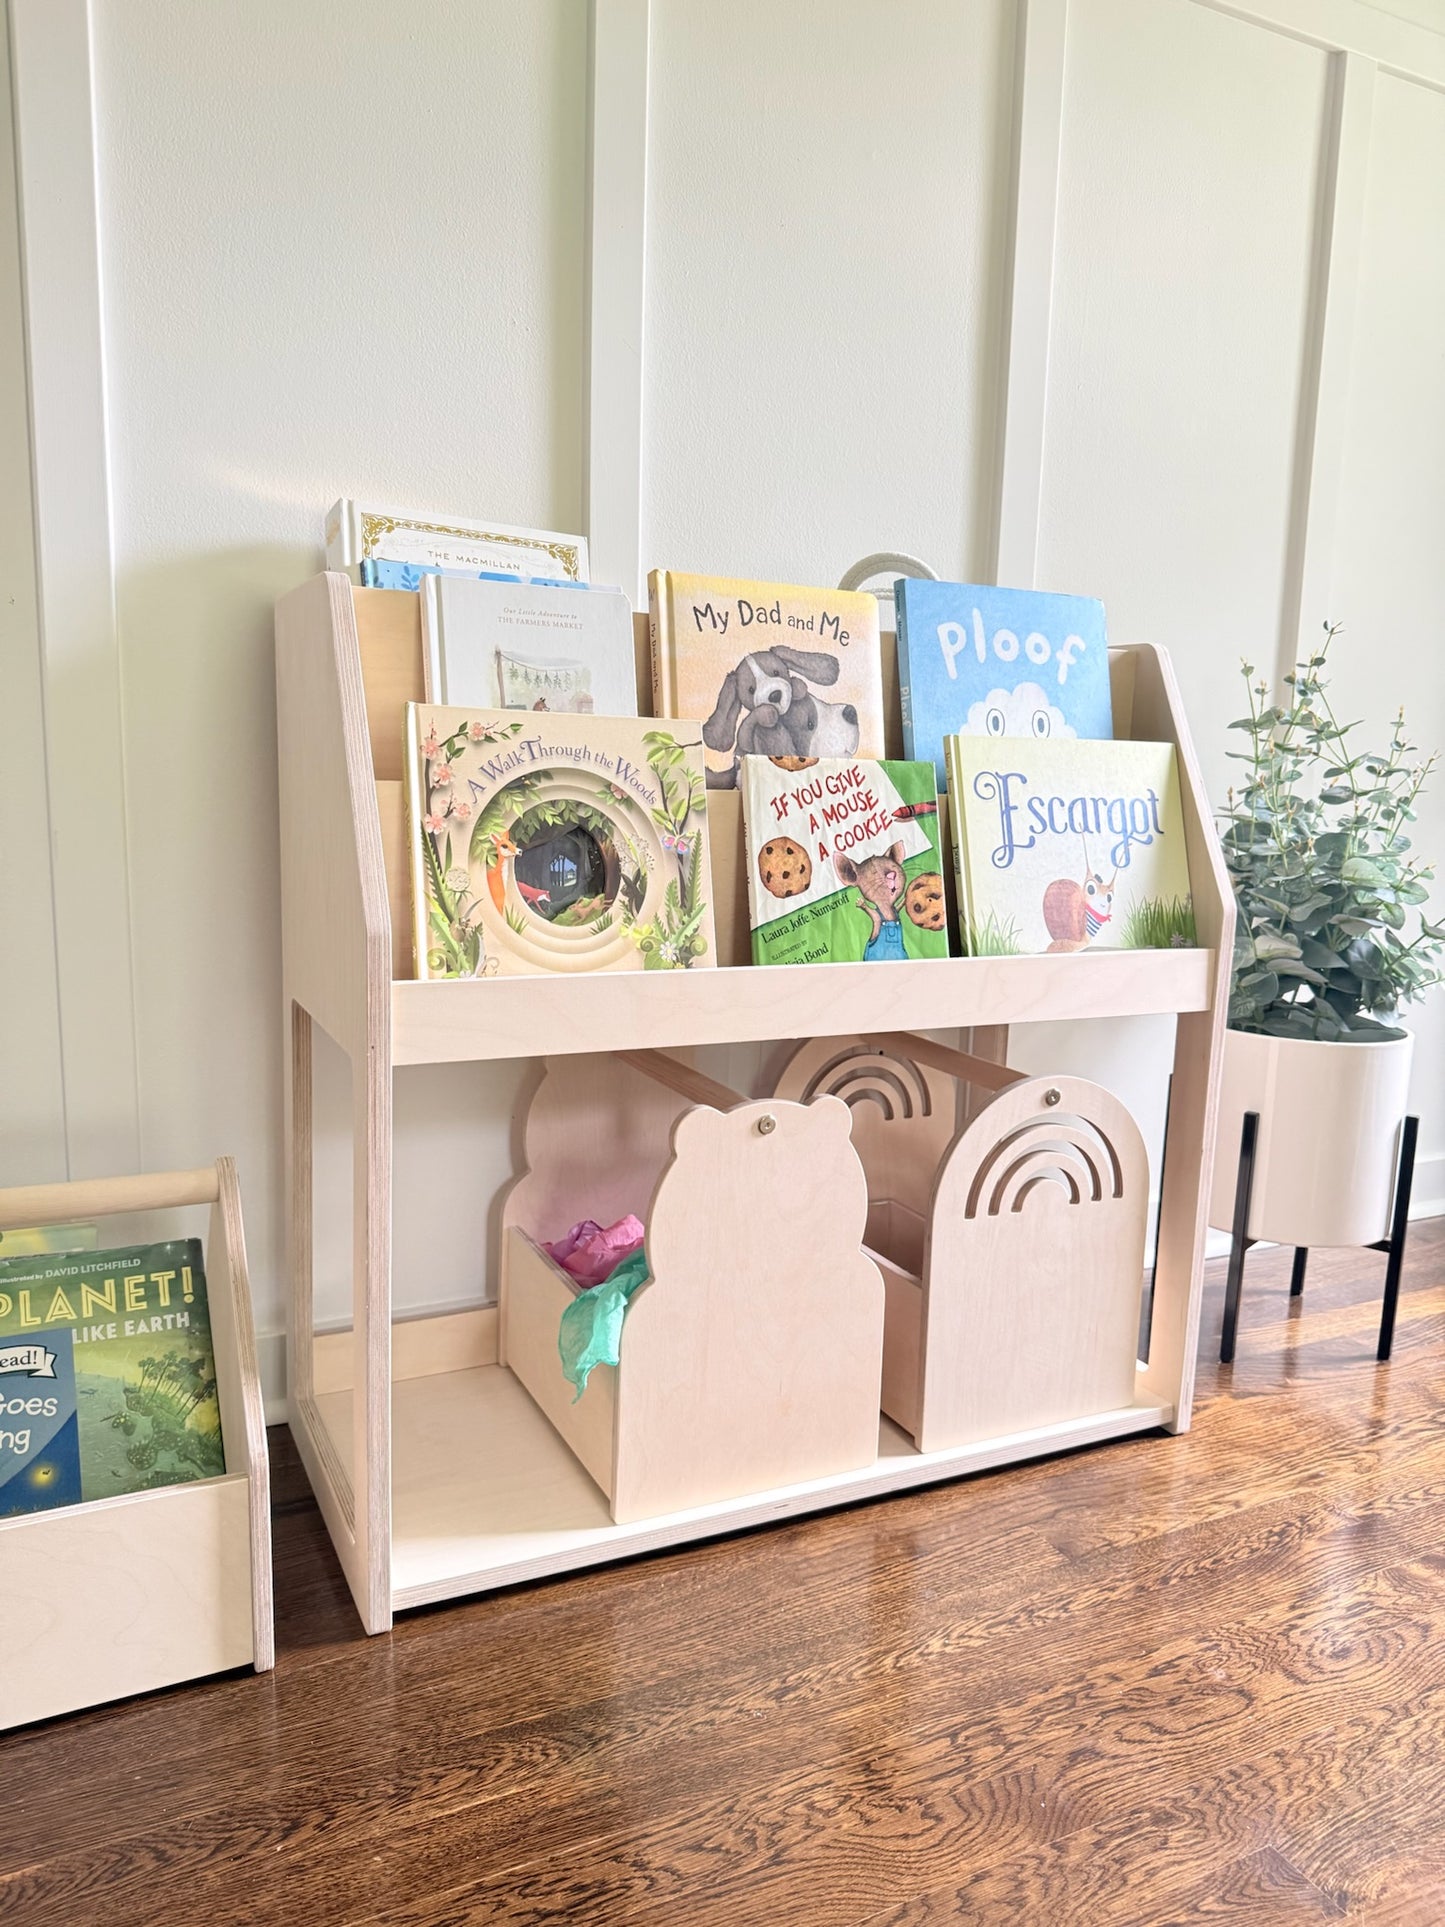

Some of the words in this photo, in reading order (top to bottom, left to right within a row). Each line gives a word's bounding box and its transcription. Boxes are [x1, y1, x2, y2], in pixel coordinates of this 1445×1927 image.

[428, 550, 449, 561] THE
[456, 556, 520, 571] MACMILLAN
[497, 616, 513, 624] THE
[516, 617, 550, 627] FARMERS
[552, 621, 584, 630] MARKET
[503, 606, 516, 614] Our
[692, 602, 729, 634] My
[737, 599, 782, 627] Dad
[787, 614, 814, 631] and
[819, 611, 850, 647] Me
[466, 779, 487, 804] A
[479, 751, 525, 782] Walk
[519, 735, 598, 764] Through
[595, 752, 614, 769] the
[614, 755, 658, 806] Woods
[770, 792, 790, 822] IF
[790, 779, 823, 810] YOU
[825, 765, 866, 796] GIVE
[809, 813, 820, 835] A
[821, 789, 879, 827] MOUSE
[973, 770, 1165, 870] Escargot
[818, 842, 830, 862] A
[834, 809, 893, 852] COOKIE
[761, 925, 790, 944] Laura
[789, 913, 810, 933] Joffe
[809, 892, 850, 920] Numeroff
[803, 942, 829, 963] Bond
[45, 1265, 79, 1279] DAVID
[81, 1258, 141, 1274] LITCHFIELD
[72, 1322, 118, 1345] LIKE
[124, 1312, 190, 1336] EARTH
